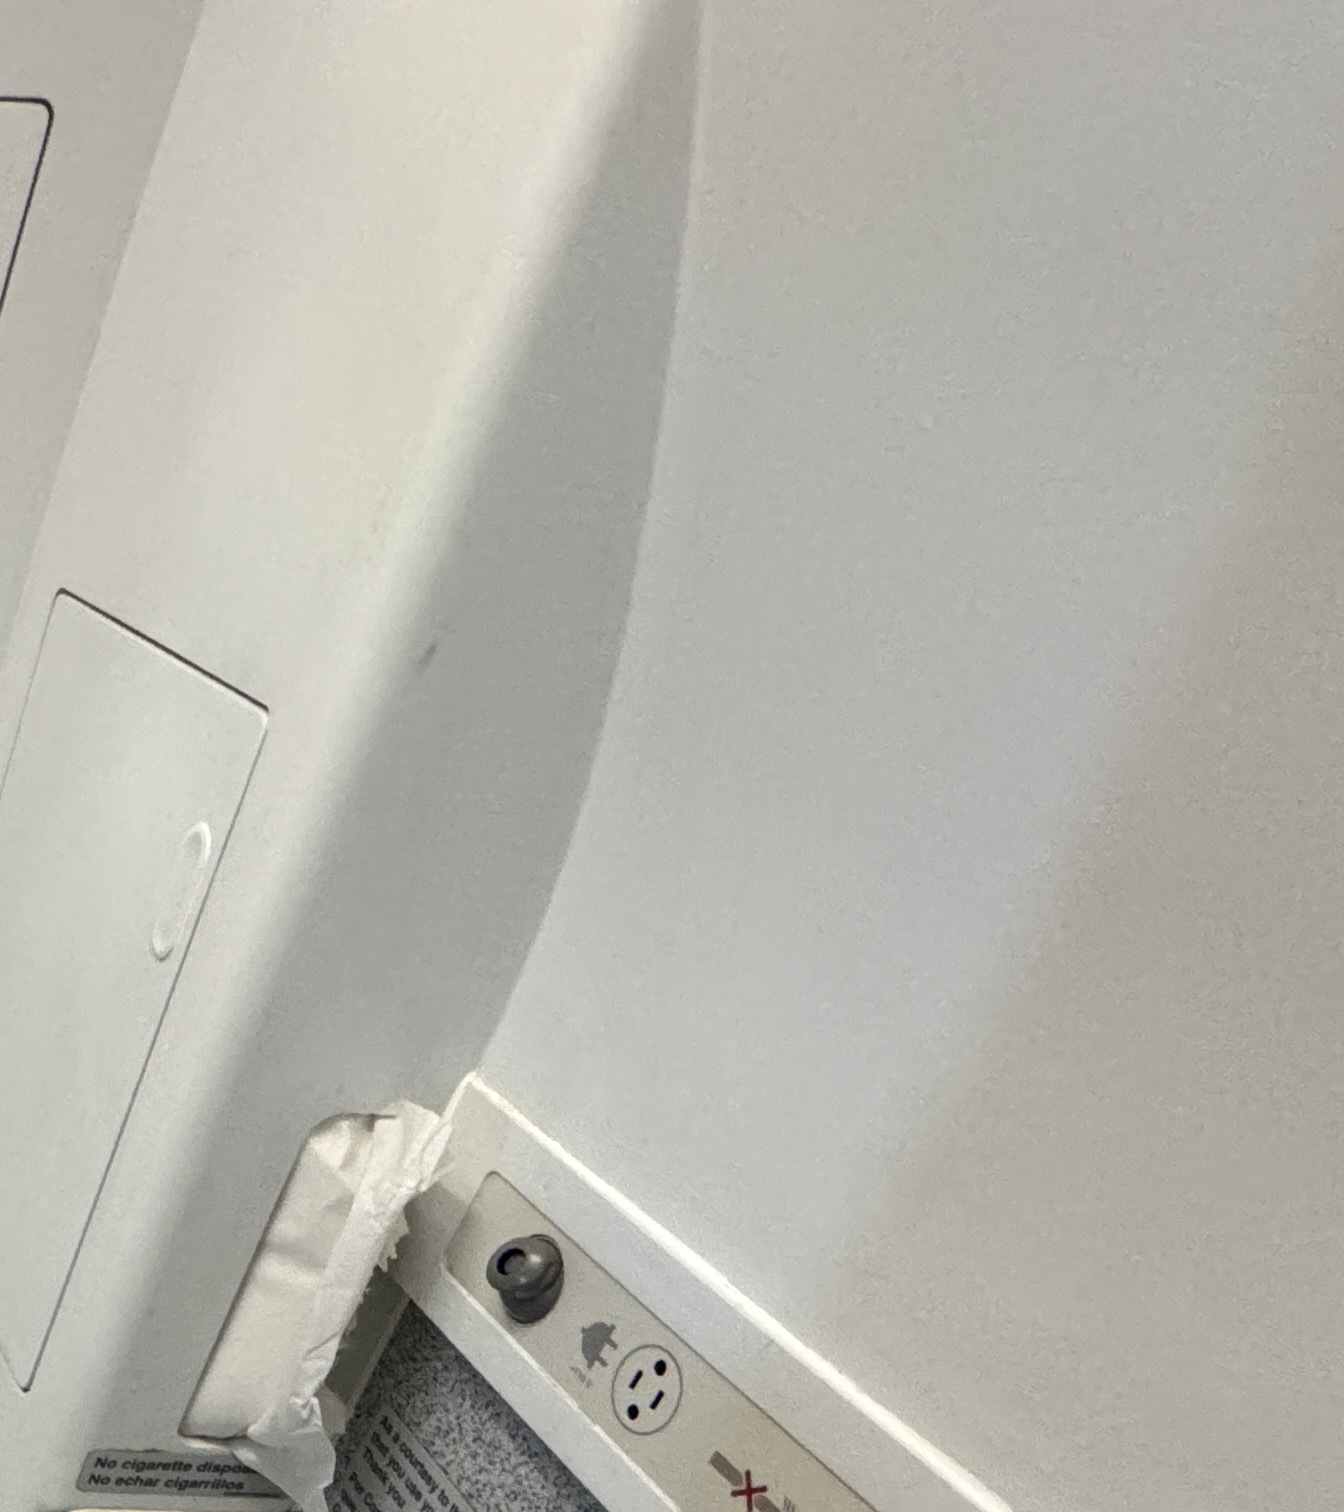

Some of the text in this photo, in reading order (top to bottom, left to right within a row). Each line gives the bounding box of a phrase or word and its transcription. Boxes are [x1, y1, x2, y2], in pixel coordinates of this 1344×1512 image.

[93, 1456, 258, 1476] No cigarette dispos
[382, 1453, 405, 1479] you
[404, 1476, 422, 1501] use
[394, 1440, 438, 1494] courtesy
[437, 1488, 449, 1507] to
[88, 1473, 245, 1492] No echar cigarrillos
[382, 1481, 406, 1509] you
